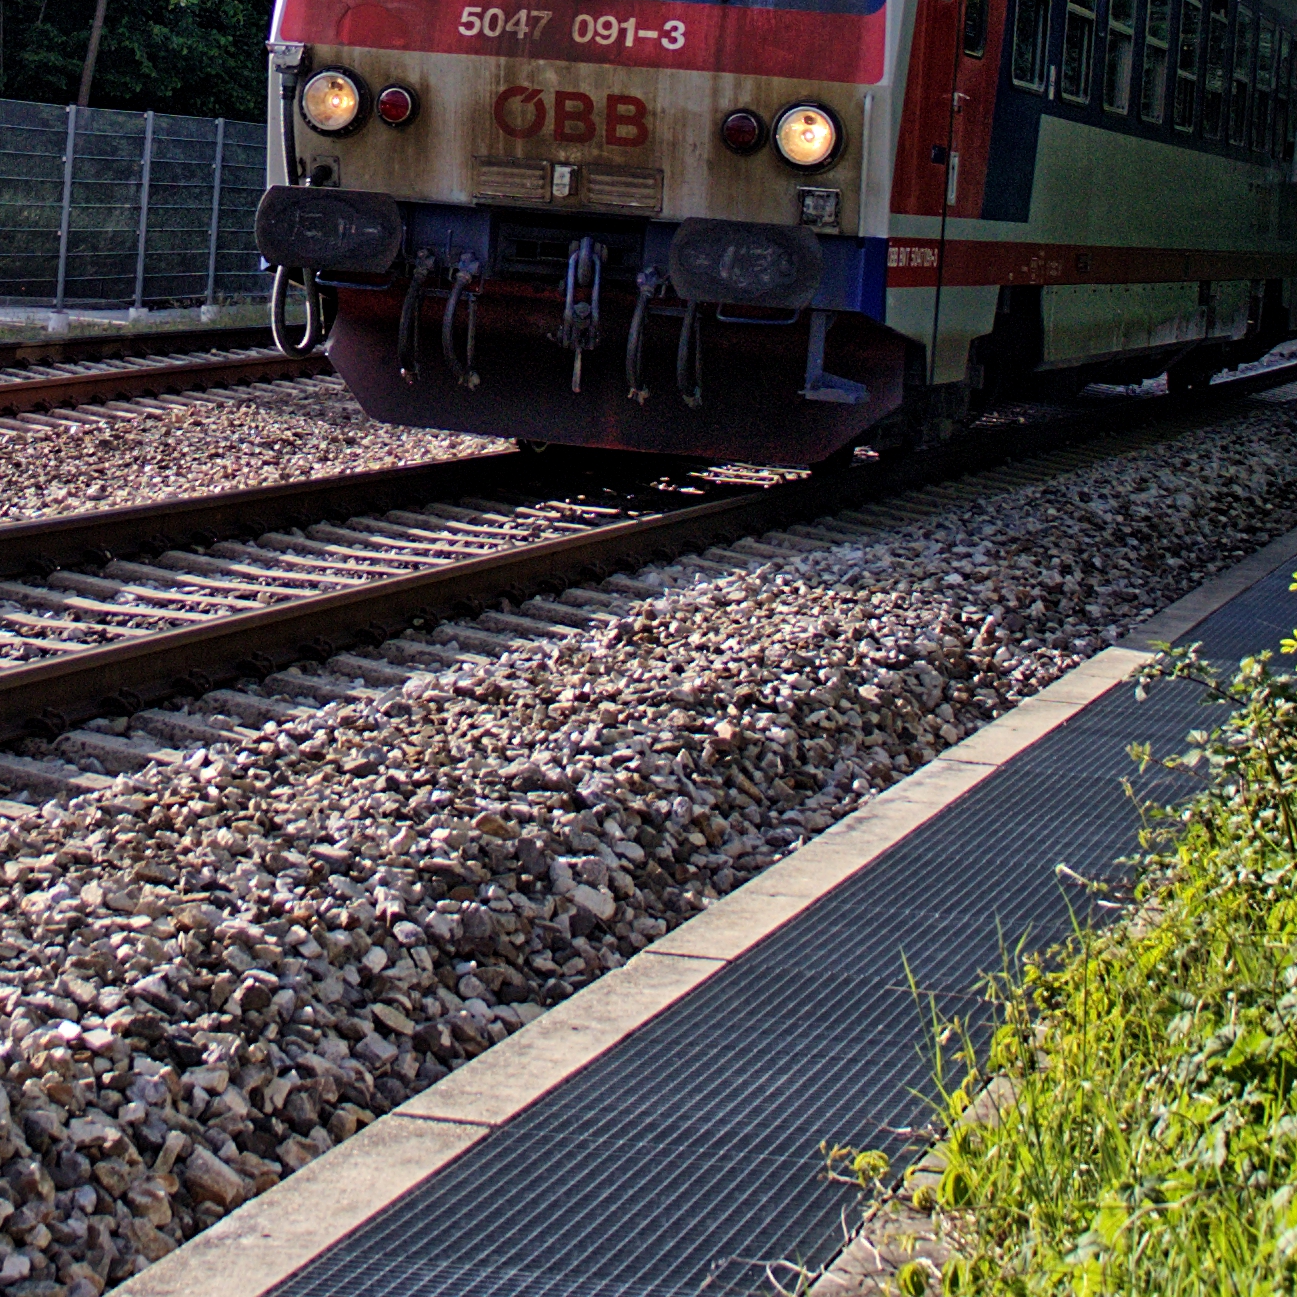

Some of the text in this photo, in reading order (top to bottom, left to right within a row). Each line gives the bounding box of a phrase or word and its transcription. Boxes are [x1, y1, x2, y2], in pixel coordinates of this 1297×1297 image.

[458, 6, 686, 50] 5047 091-3
[493, 85, 649, 148] ÖBB
